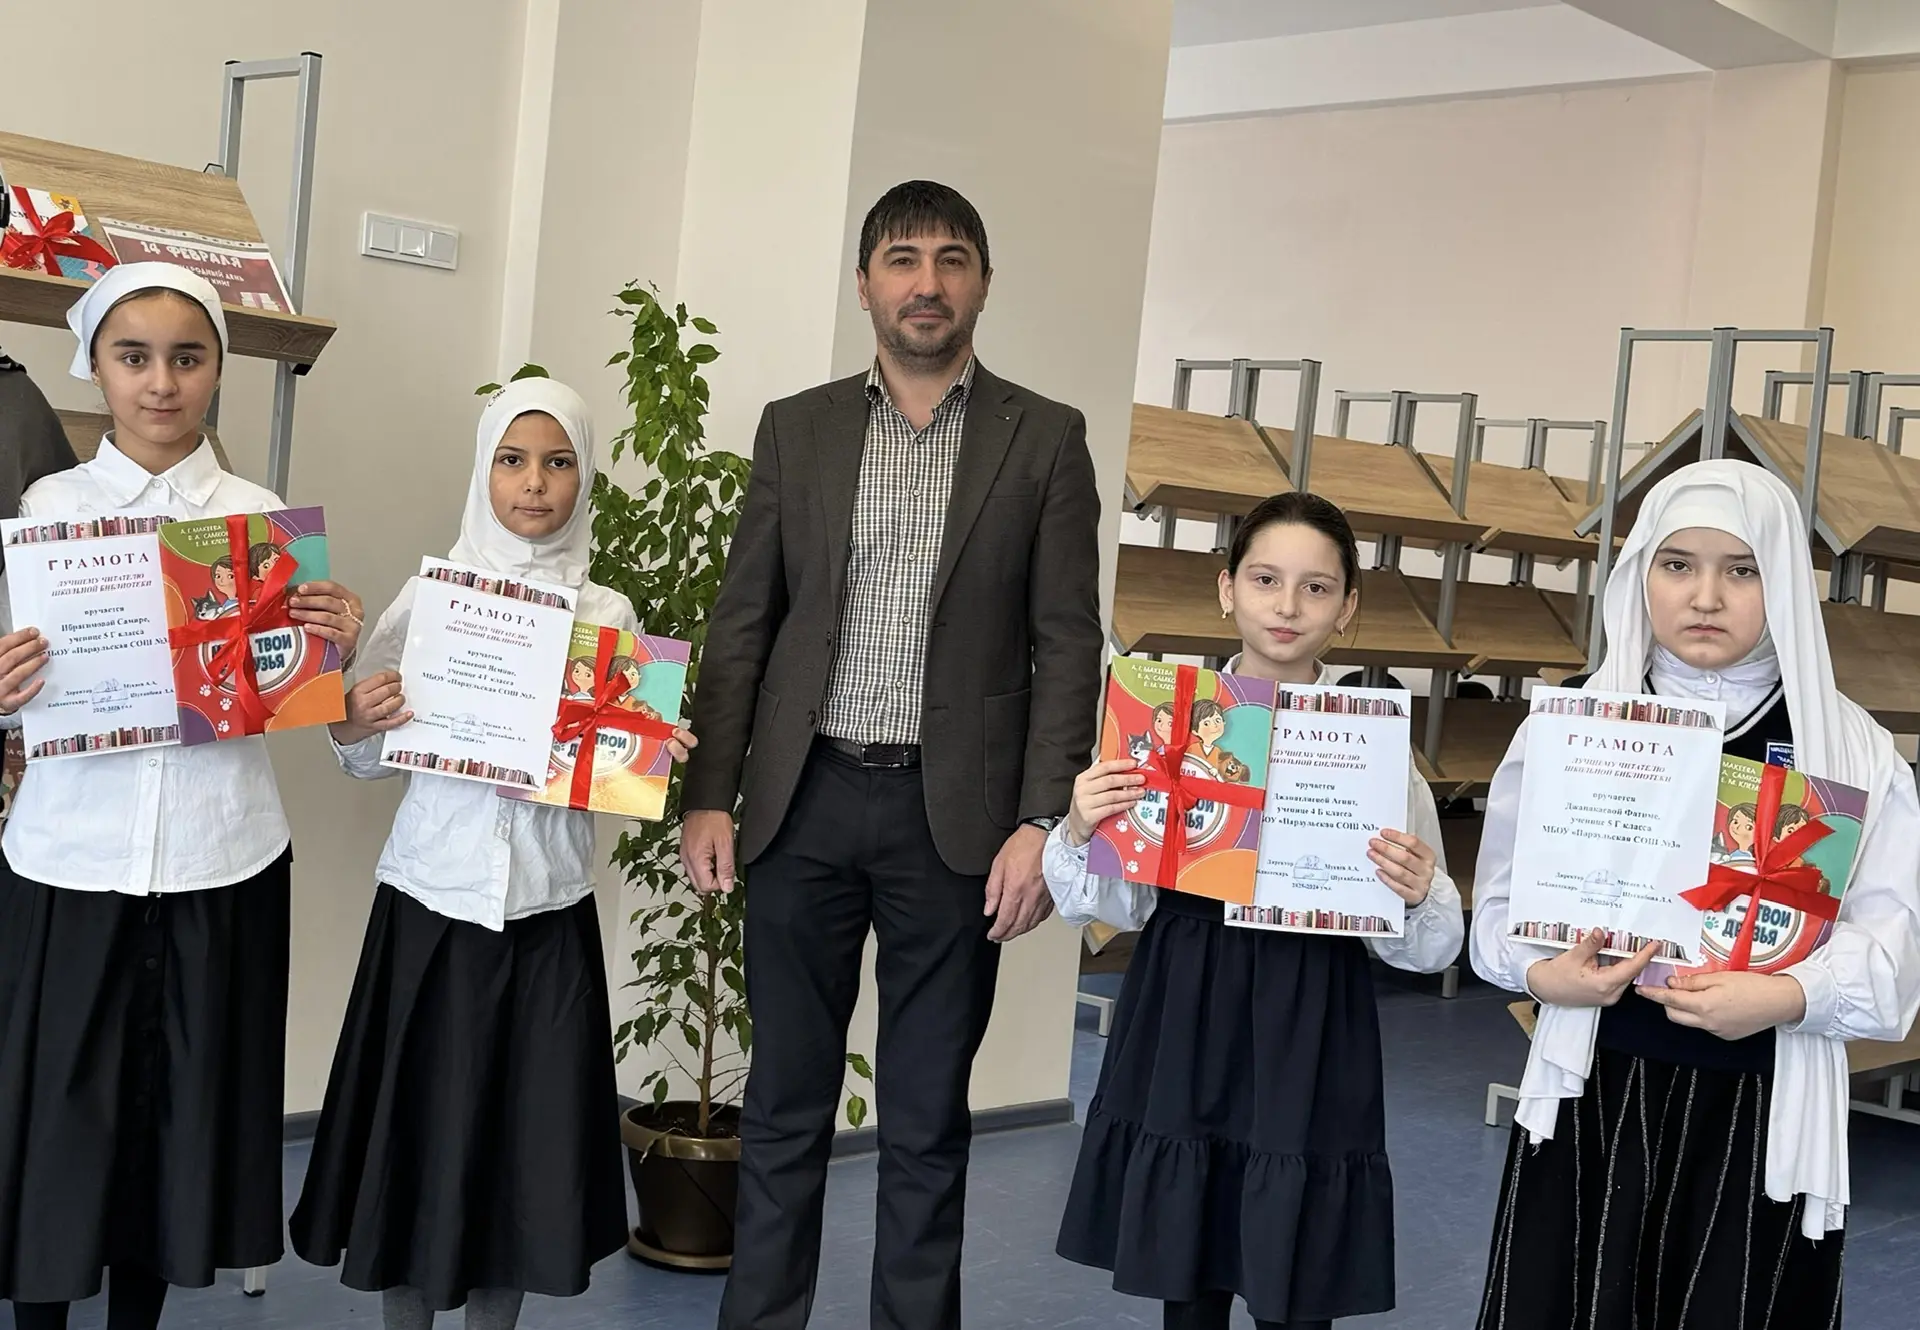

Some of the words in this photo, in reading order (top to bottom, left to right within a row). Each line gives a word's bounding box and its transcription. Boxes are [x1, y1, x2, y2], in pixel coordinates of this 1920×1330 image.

[141, 241, 161, 255] 14
[166, 245, 243, 268] ФЕВРАЛЯ
[48, 552, 149, 571] ГРАМОТА
[51, 586, 98, 597] ШКОЛЬНОЙ
[100, 580, 152, 592] БИБЛИОТЕКИ
[57, 576, 99, 587] ЛУЧШЕМУ
[102, 573, 145, 584] ЧИТАТЕЛЮ
[84, 606, 125, 616] вручается
[450, 600, 536, 628] ГРАМОТА
[61, 620, 116, 632] Ибрагимовой
[452, 619, 489, 632] ЛУЧШЕМУ
[490, 628, 529, 640] ЧИТАТЕЛЮ
[68, 634, 102, 644] ученице
[118, 629, 144, 638] класса
[130, 638, 152, 648] СОШ
[154, 636, 169, 646] №3
[255, 634, 292, 653] ТВОИ
[445, 625, 486, 638] ШКОЛЬНОЙ
[486, 634, 533, 648] БИБЛИОТЕКИ
[255, 653, 285, 672] УЗЬЯ
[468, 650, 502, 661] вручается
[421, 672, 445, 682] МБОУ
[498, 688, 518, 697] СОШ
[447, 668, 476, 678] ученице
[490, 677, 514, 686] класса
[1154, 675, 1176, 684] САМКО
[596, 732, 627, 750] ТВОИ
[1567, 734, 1674, 756] ГРАМОТА
[1274, 750, 1314, 758] ЛУЧШЕМУ
[1316, 752, 1360, 762] ЧИТАТЕЛЮ
[1314, 760, 1367, 770] БИБЛИОТЕКИ
[1572, 757, 1618, 768] ЛУЧШЕМУ
[1618, 762, 1666, 774] ЧИТАТЕЛЮ
[1564, 766, 1614, 777] ШКОЛЬНОЙ
[1614, 770, 1672, 783] БИБЛИОТЕКИ
[1296, 782, 1336, 790] вручается
[1592, 792, 1636, 802] вручается
[1276, 806, 1309, 814] ученице
[1326, 810, 1352, 818] класса
[1336, 822, 1359, 830] СОШ
[1570, 817, 1605, 826] ученице
[1622, 822, 1652, 832] класса
[1542, 824, 1569, 835] МБОУ
[1633, 835, 1659, 846] СОШ
[1757, 904, 1792, 928] ТВОИ
